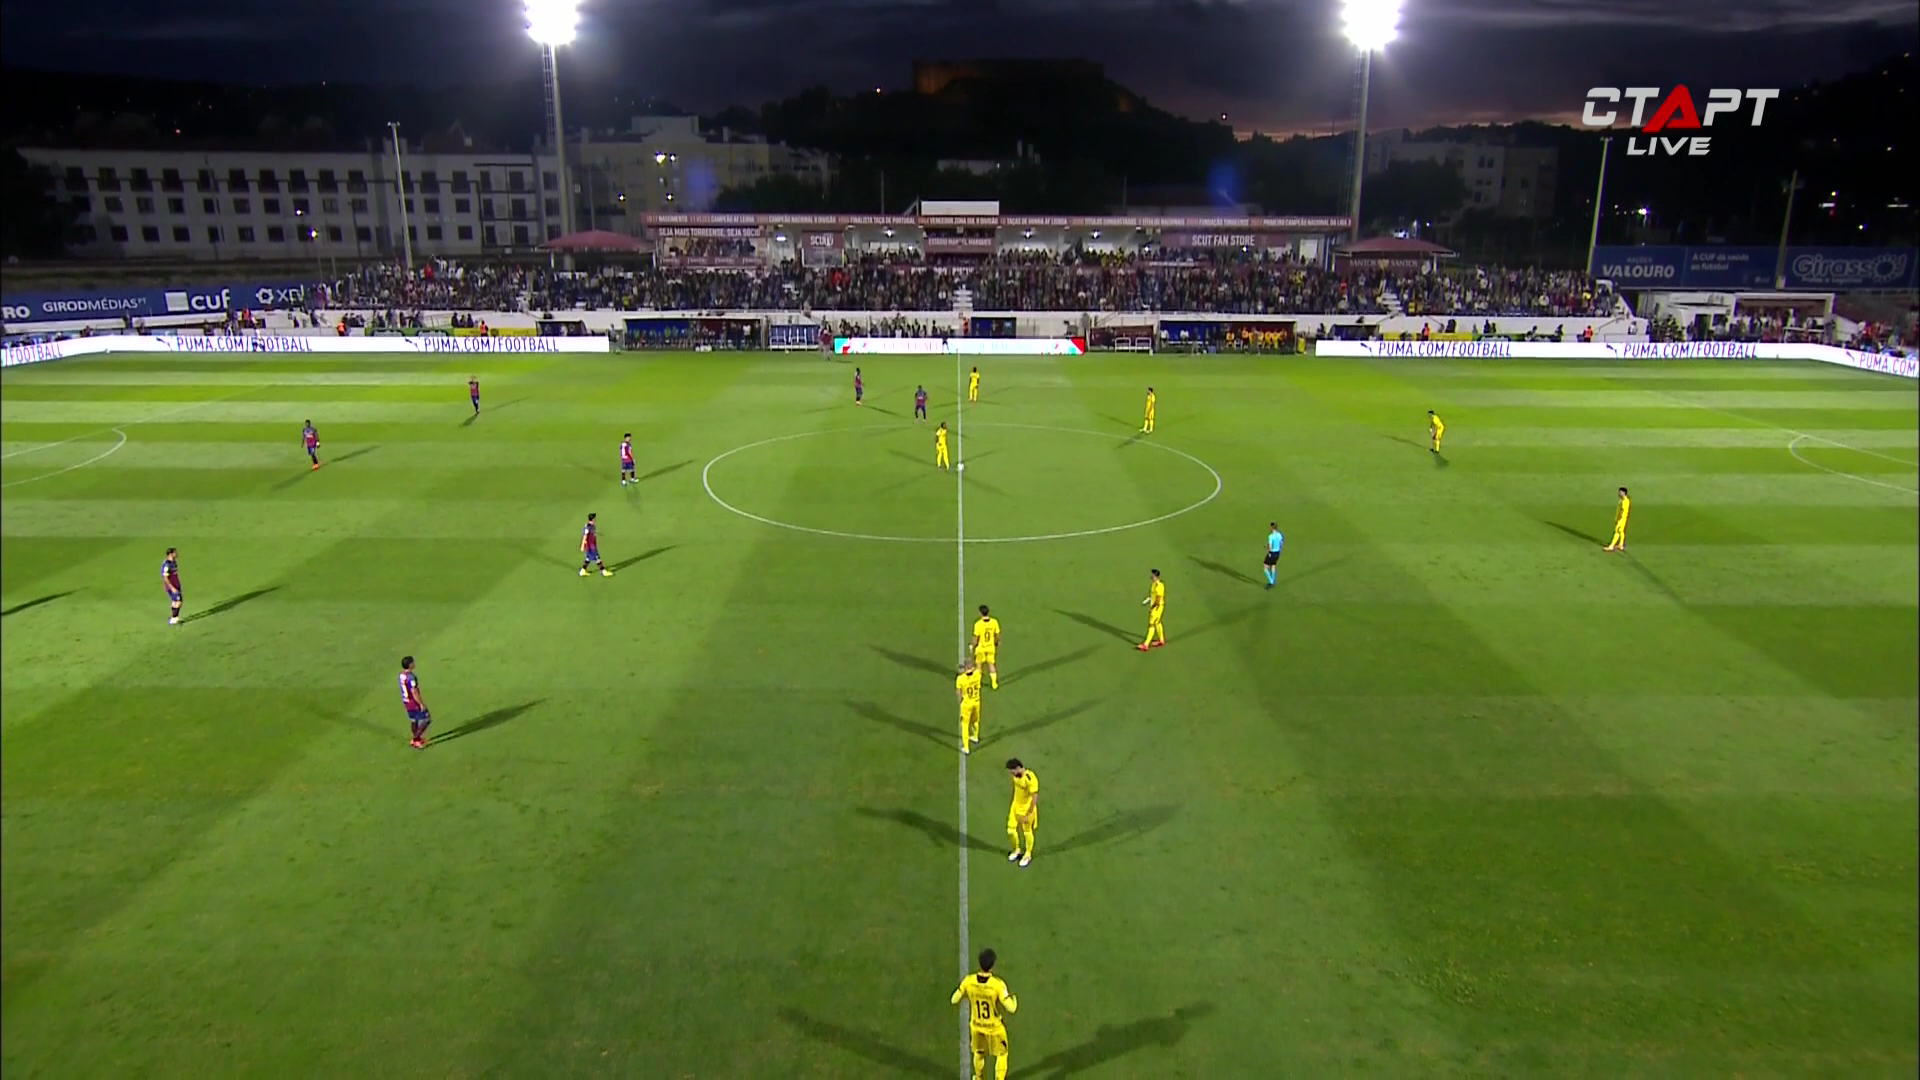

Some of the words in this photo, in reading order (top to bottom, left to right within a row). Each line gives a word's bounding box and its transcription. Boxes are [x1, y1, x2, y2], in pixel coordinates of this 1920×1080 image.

[1192, 234, 1211, 246] SCUT
[1213, 234, 1228, 246] FAN
[1230, 234, 1255, 246] STORE
[1602, 264, 1675, 278] VALOURO
[424, 337, 559, 351] PUMA.COM/FOOTBALL
[1378, 341, 1512, 357] PUMA.COM/FOOTBALL
[1624, 342, 1758, 358] PUMA.COM/FOOTBALL
[984, 631, 991, 643] 9
[976, 1000, 991, 1019] 13
